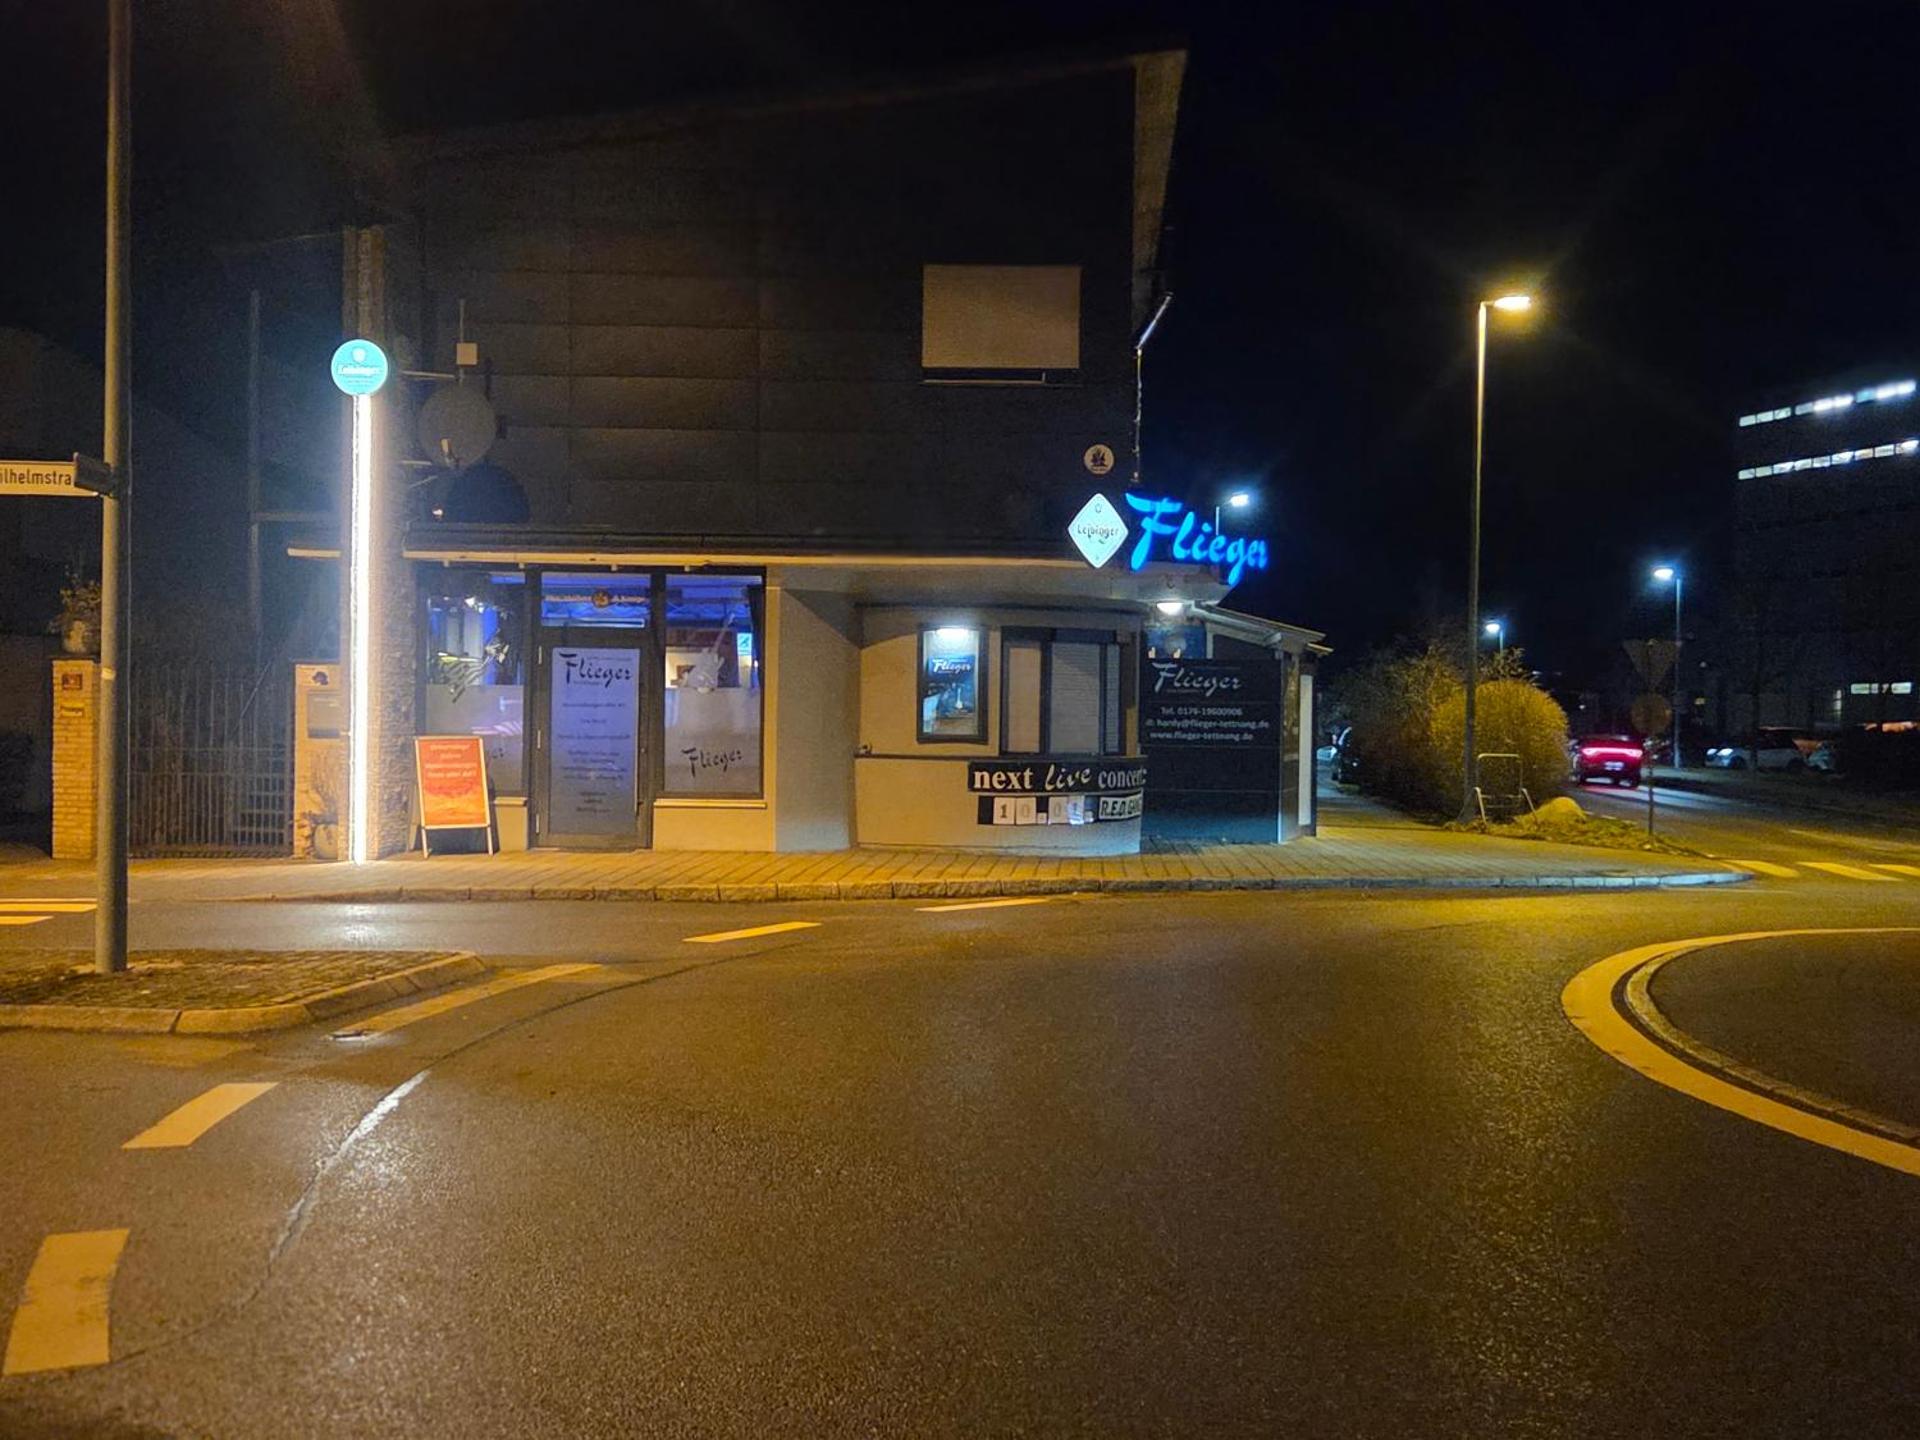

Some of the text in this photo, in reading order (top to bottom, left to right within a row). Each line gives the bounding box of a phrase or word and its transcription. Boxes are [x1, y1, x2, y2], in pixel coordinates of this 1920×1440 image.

[1125, 493, 1268, 587] Flieger
[559, 652, 632, 688] Flieger
[1151, 662, 1242, 697] Flieger
[973, 767, 1034, 790] next
[1044, 764, 1091, 791] live
